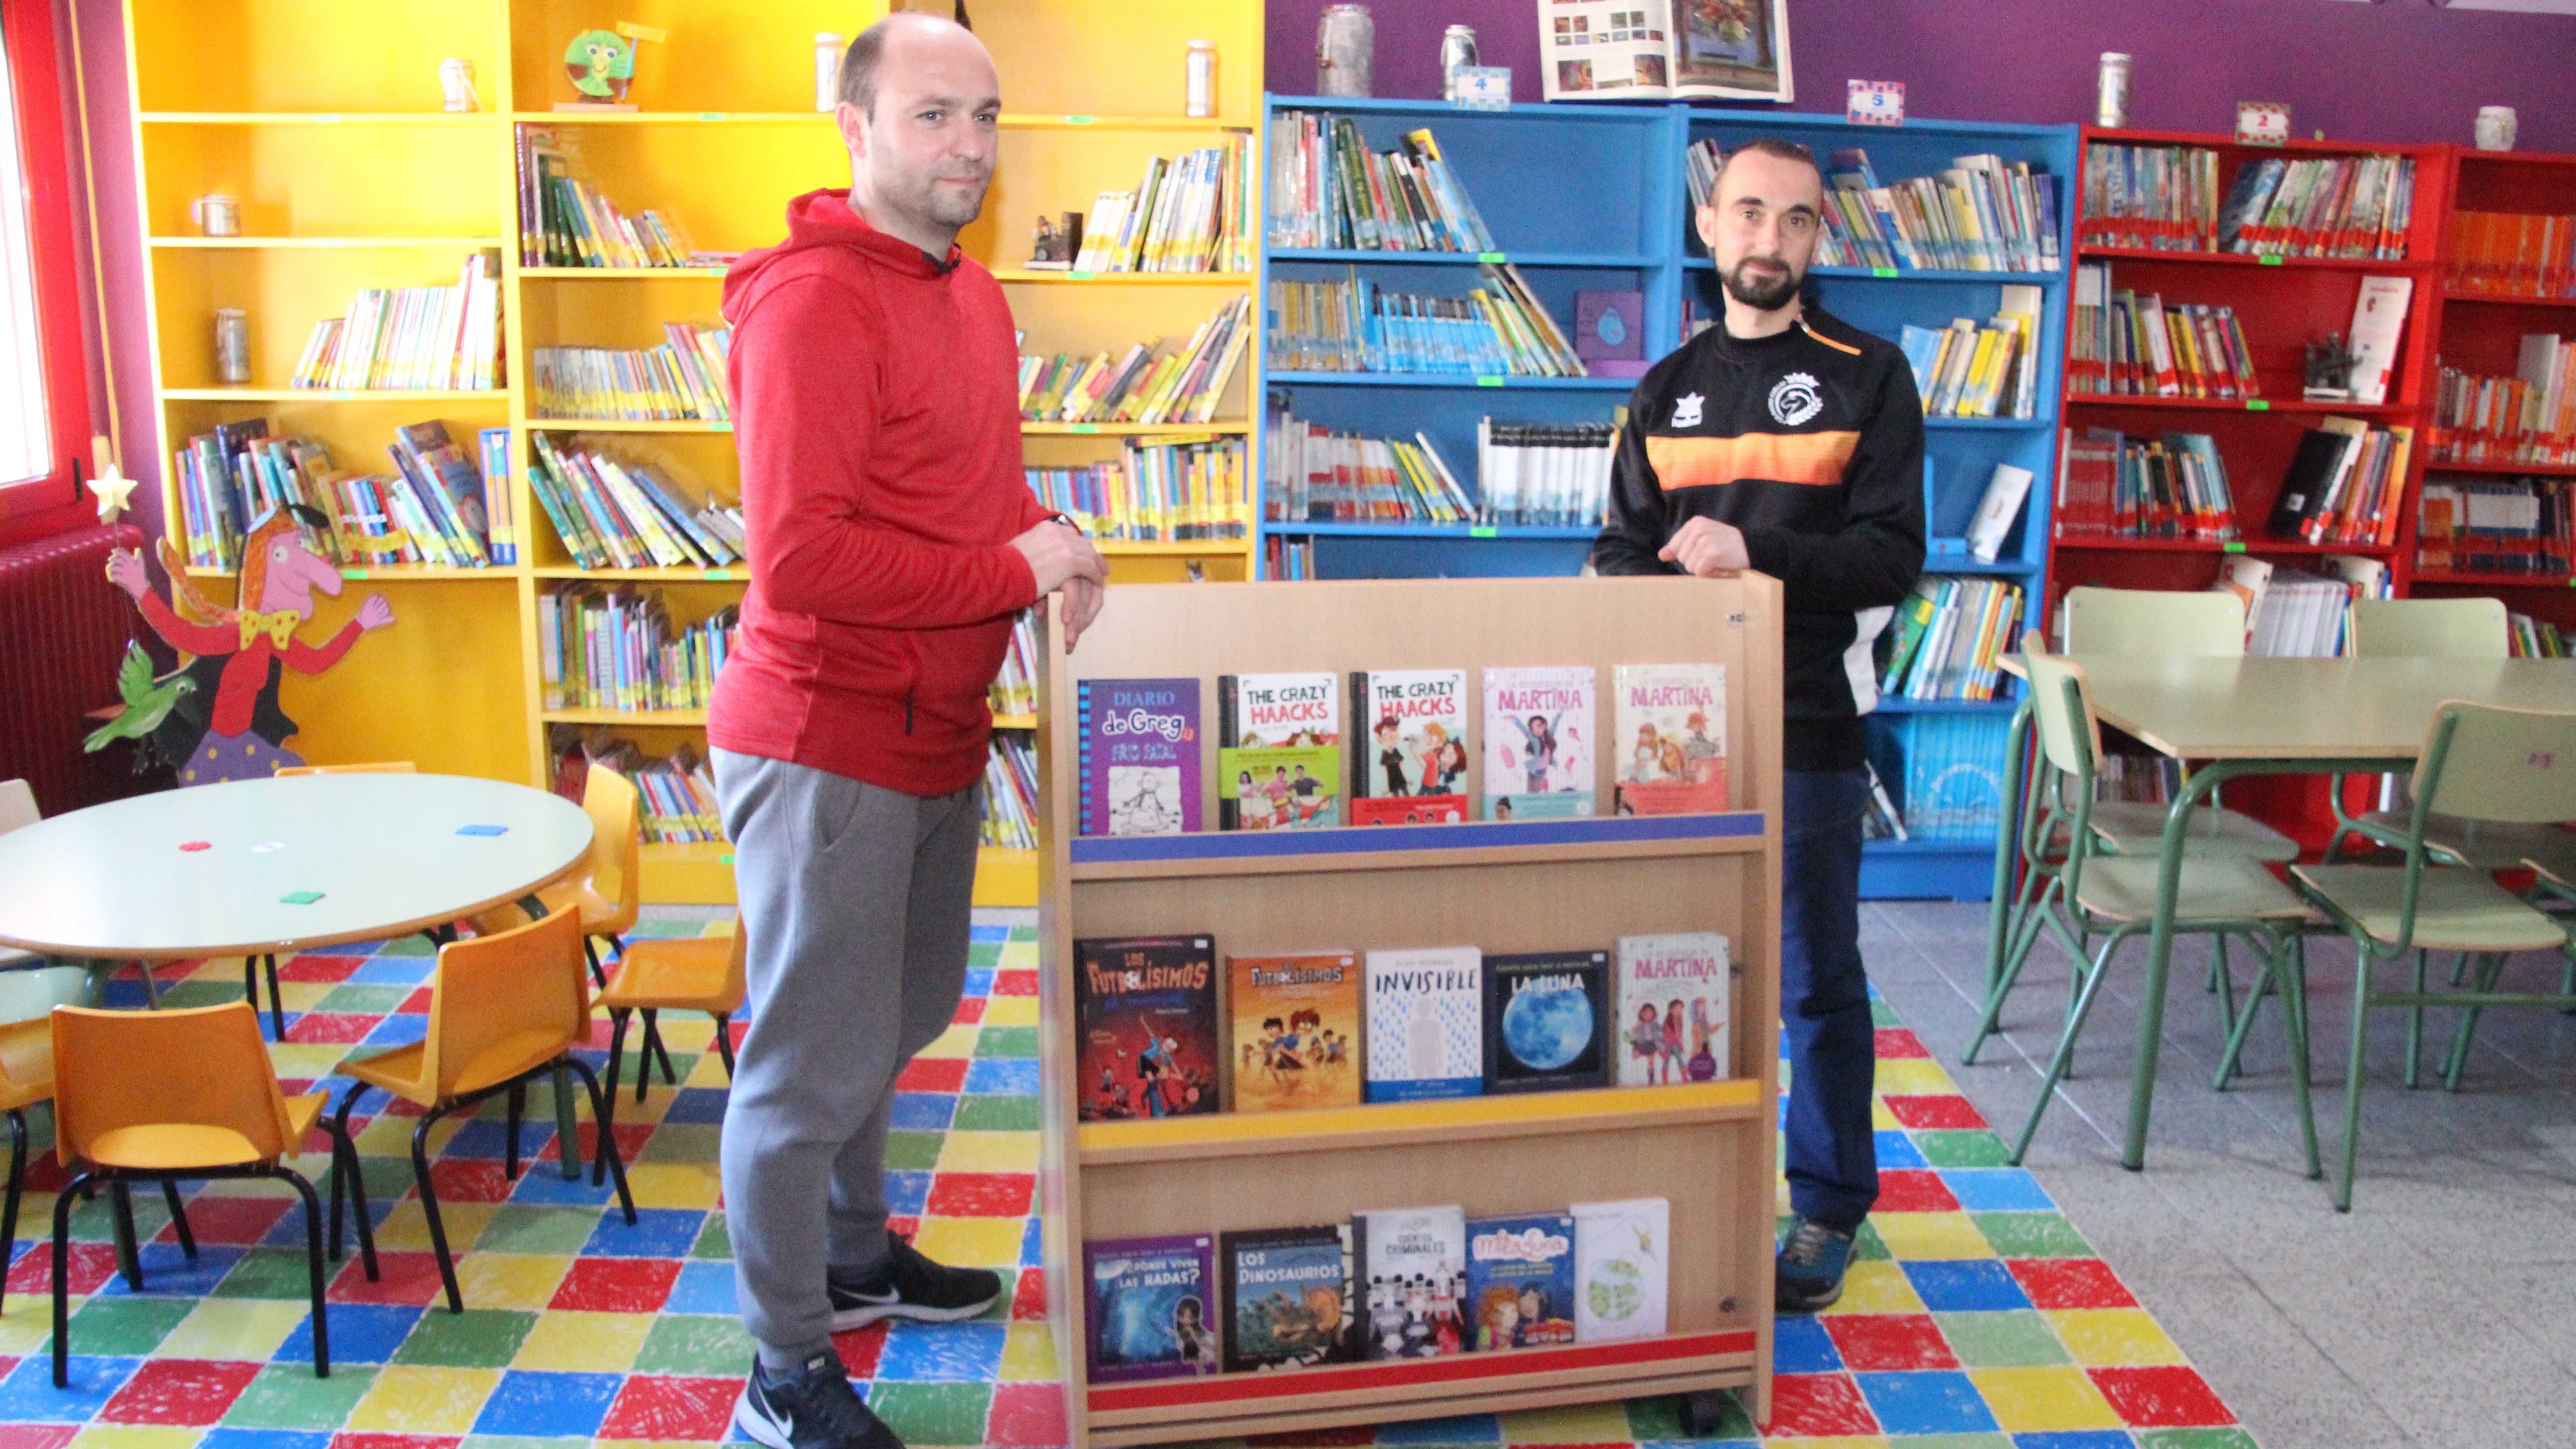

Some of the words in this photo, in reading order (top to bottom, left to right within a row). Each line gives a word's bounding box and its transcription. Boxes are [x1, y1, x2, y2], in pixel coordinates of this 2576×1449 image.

[1872, 94, 1884, 106] 5
[2257, 115, 2268, 127] 2
[1114, 691, 1175, 707] DIARIO
[1248, 689, 1275, 704] THE
[1280, 685, 1327, 702] CRAZY
[1376, 685, 1404, 699] THE
[1409, 681, 1455, 697] CRAZY
[1498, 689, 1583, 711] MARTINA
[1630, 686, 1713, 708] MARTINA
[1250, 702, 1328, 724] HAACKS
[1380, 697, 1456, 720] HAACKS
[1102, 710, 1128, 735] de
[1128, 708, 1185, 742] Greg
[1635, 956, 1717, 980] MARTINA
[1376, 969, 1477, 995] INVISIBLE
[1512, 975, 1532, 994] LA
[1238, 1251, 1266, 1267] LOS
[1239, 1264, 1340, 1284] DINOSAURIOS
